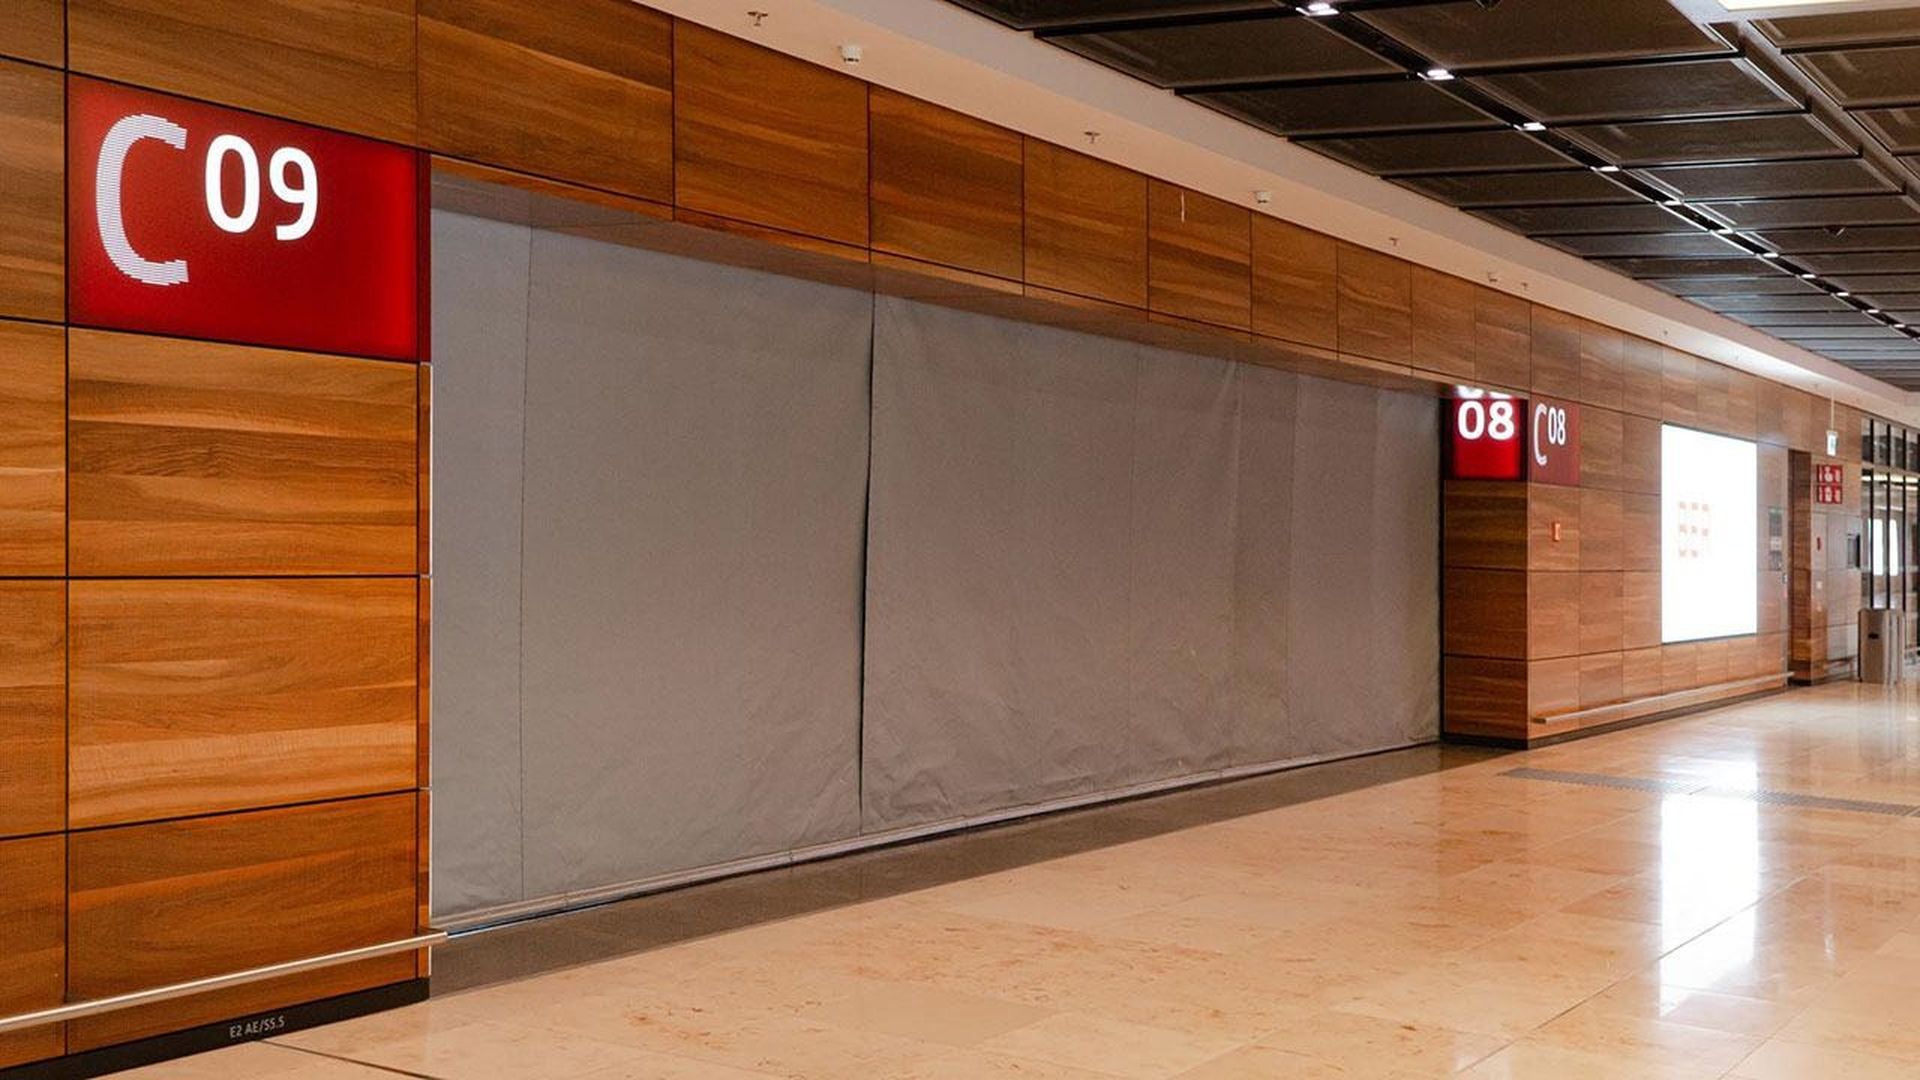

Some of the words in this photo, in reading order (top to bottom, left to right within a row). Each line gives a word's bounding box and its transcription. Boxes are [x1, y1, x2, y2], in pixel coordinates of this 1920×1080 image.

[96, 114, 189, 286] C
[205, 135, 318, 241] 09
[1458, 401, 1515, 441] 08
[1549, 407, 1566, 446] 08
[229, 1025, 243, 1039] E2
